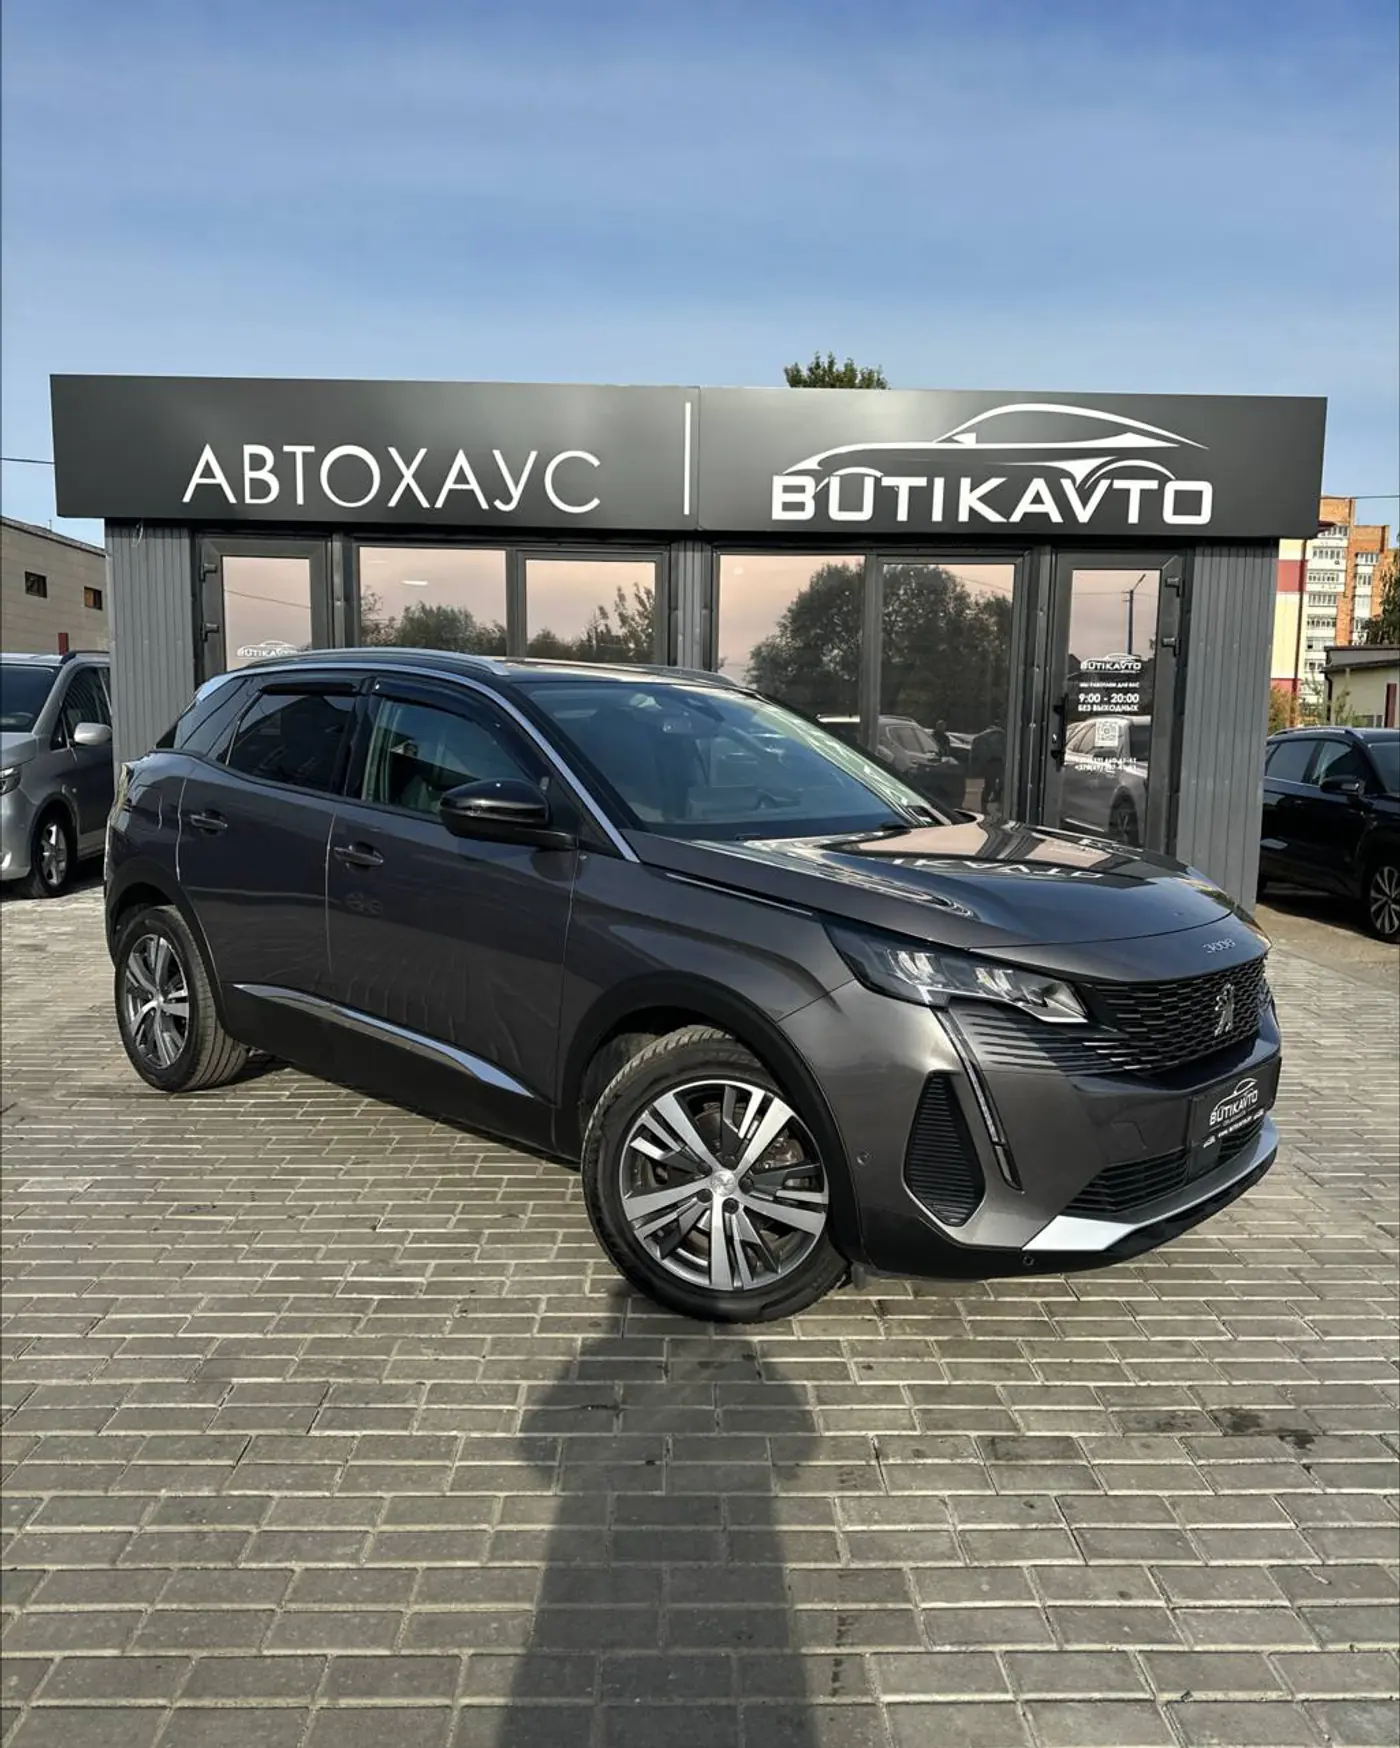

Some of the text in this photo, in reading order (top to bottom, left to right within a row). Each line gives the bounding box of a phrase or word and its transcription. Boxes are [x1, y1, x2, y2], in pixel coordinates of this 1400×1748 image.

[183, 443, 601, 513] АВТОХАУС
[771, 474, 1213, 526] BUTIKAVTO
[1080, 661, 1142, 670] BUTIKAVTO
[1078, 693, 1101, 703] 9:00
[1110, 693, 1140, 703] 20:00
[1092, 704, 1139, 712] ВЫХОДНЫХ
[1202, 938, 1236, 954] 3008
[1209, 1089, 1258, 1126] BUTIKAVTO
